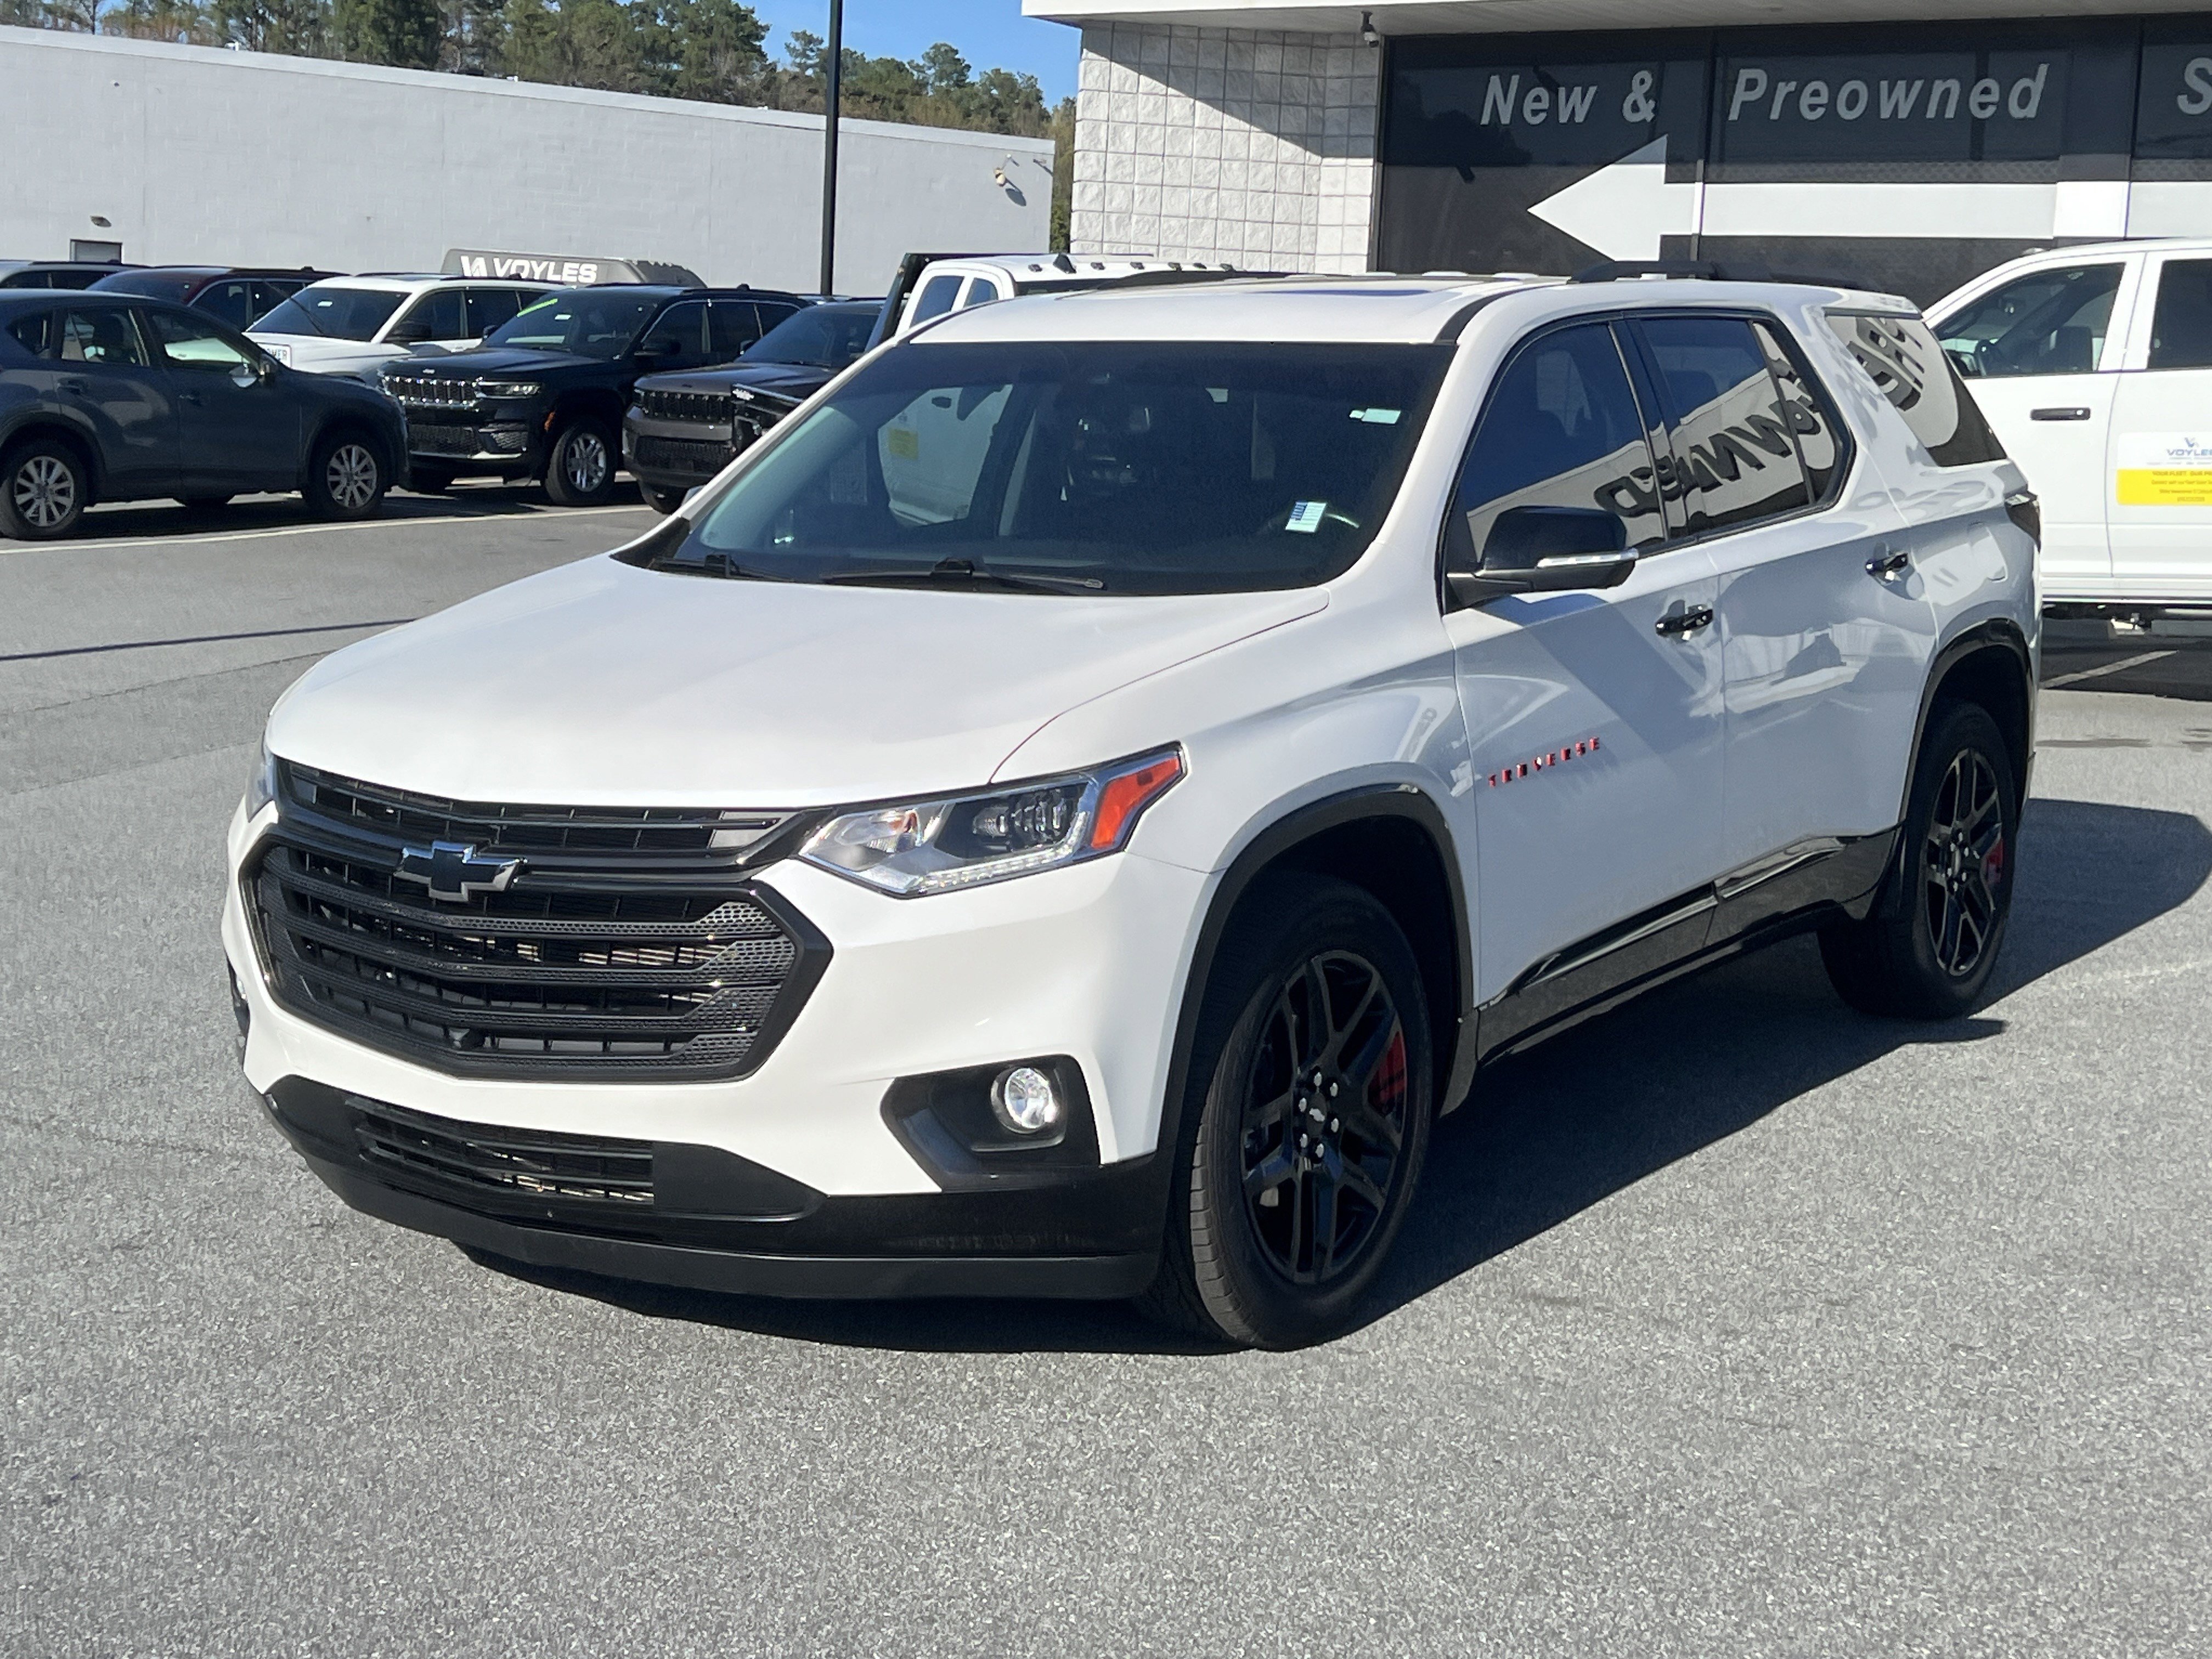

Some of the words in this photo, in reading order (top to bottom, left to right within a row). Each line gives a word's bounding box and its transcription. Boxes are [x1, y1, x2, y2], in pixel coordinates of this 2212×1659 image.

[1480, 75, 1598, 125] New
[1622, 70, 1655, 122] &
[1728, 63, 2050, 121] Preowned
[493, 257, 598, 284] VOYLES
